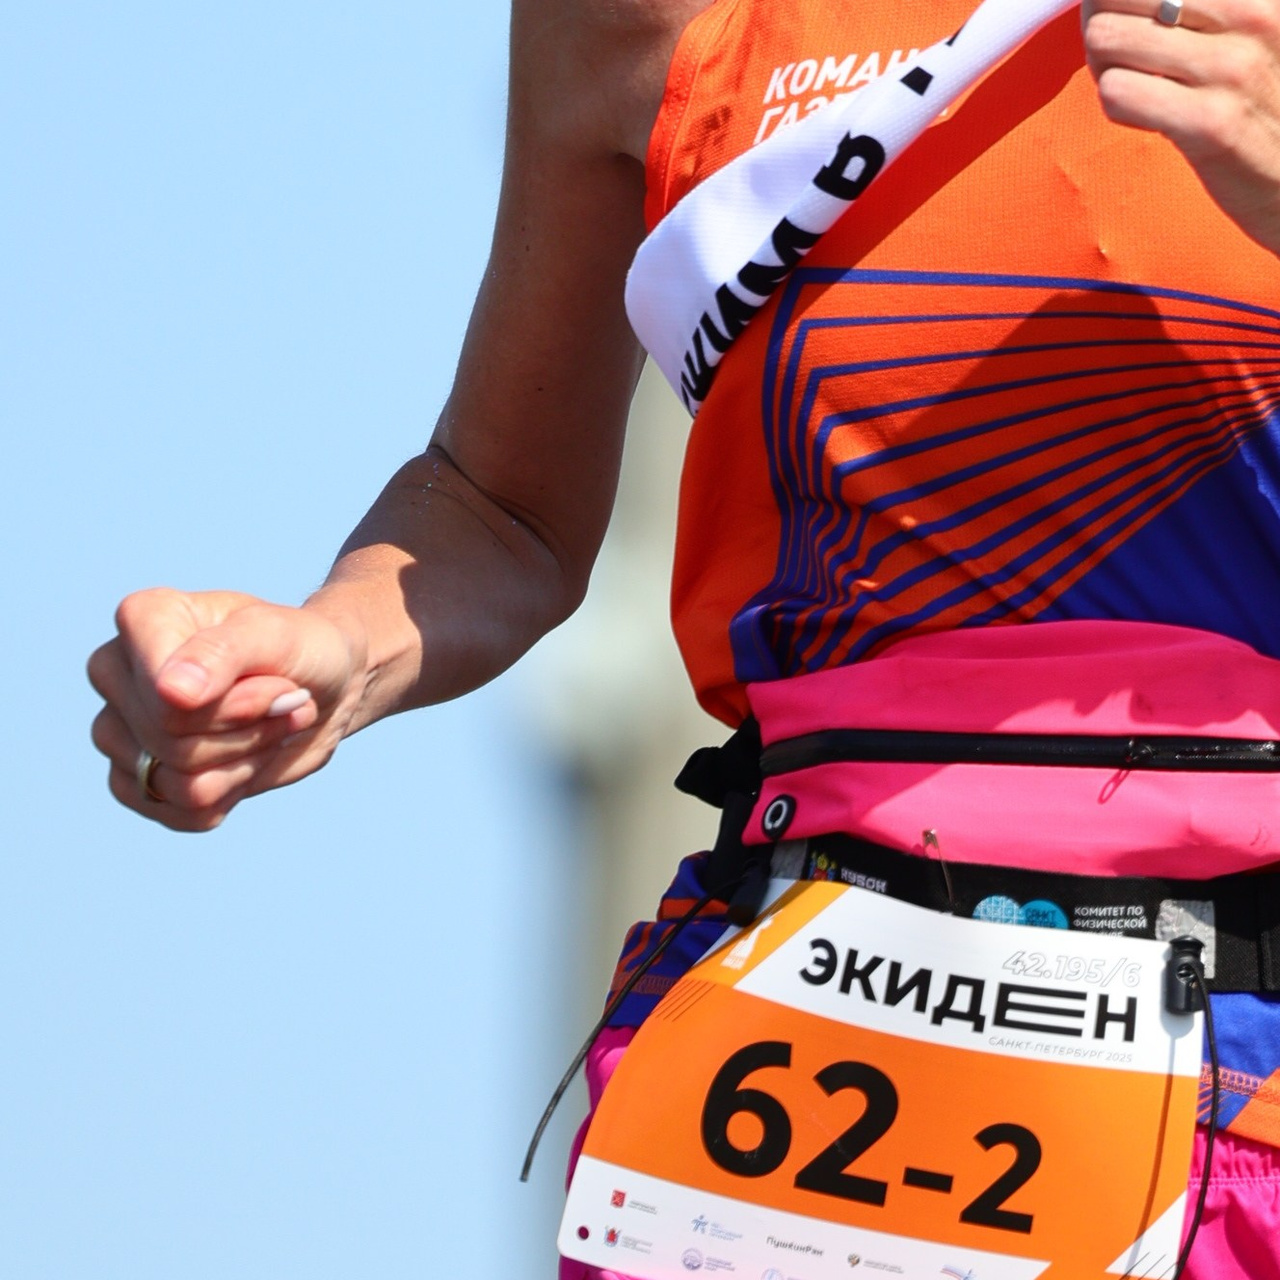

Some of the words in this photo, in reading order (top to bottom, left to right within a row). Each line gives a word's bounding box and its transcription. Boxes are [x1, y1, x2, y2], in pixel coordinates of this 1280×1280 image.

[762, 48, 920, 105] КОМАН
[1073, 916, 1148, 929] ФИЗИЧЕСКОЙ
[1074, 906, 1125, 917] КОМИТЕТ
[1127, 905, 1144, 917] ПО
[1002, 950, 1142, 988] 42.195/6
[799, 937, 1138, 1044] ЭКИДЕН
[988, 1036, 1102, 1060] САНКТ-ПЕТЕРБУРГ
[1104, 1052, 1133, 1064] 2025
[700, 1039, 1043, 1235] 62-2
